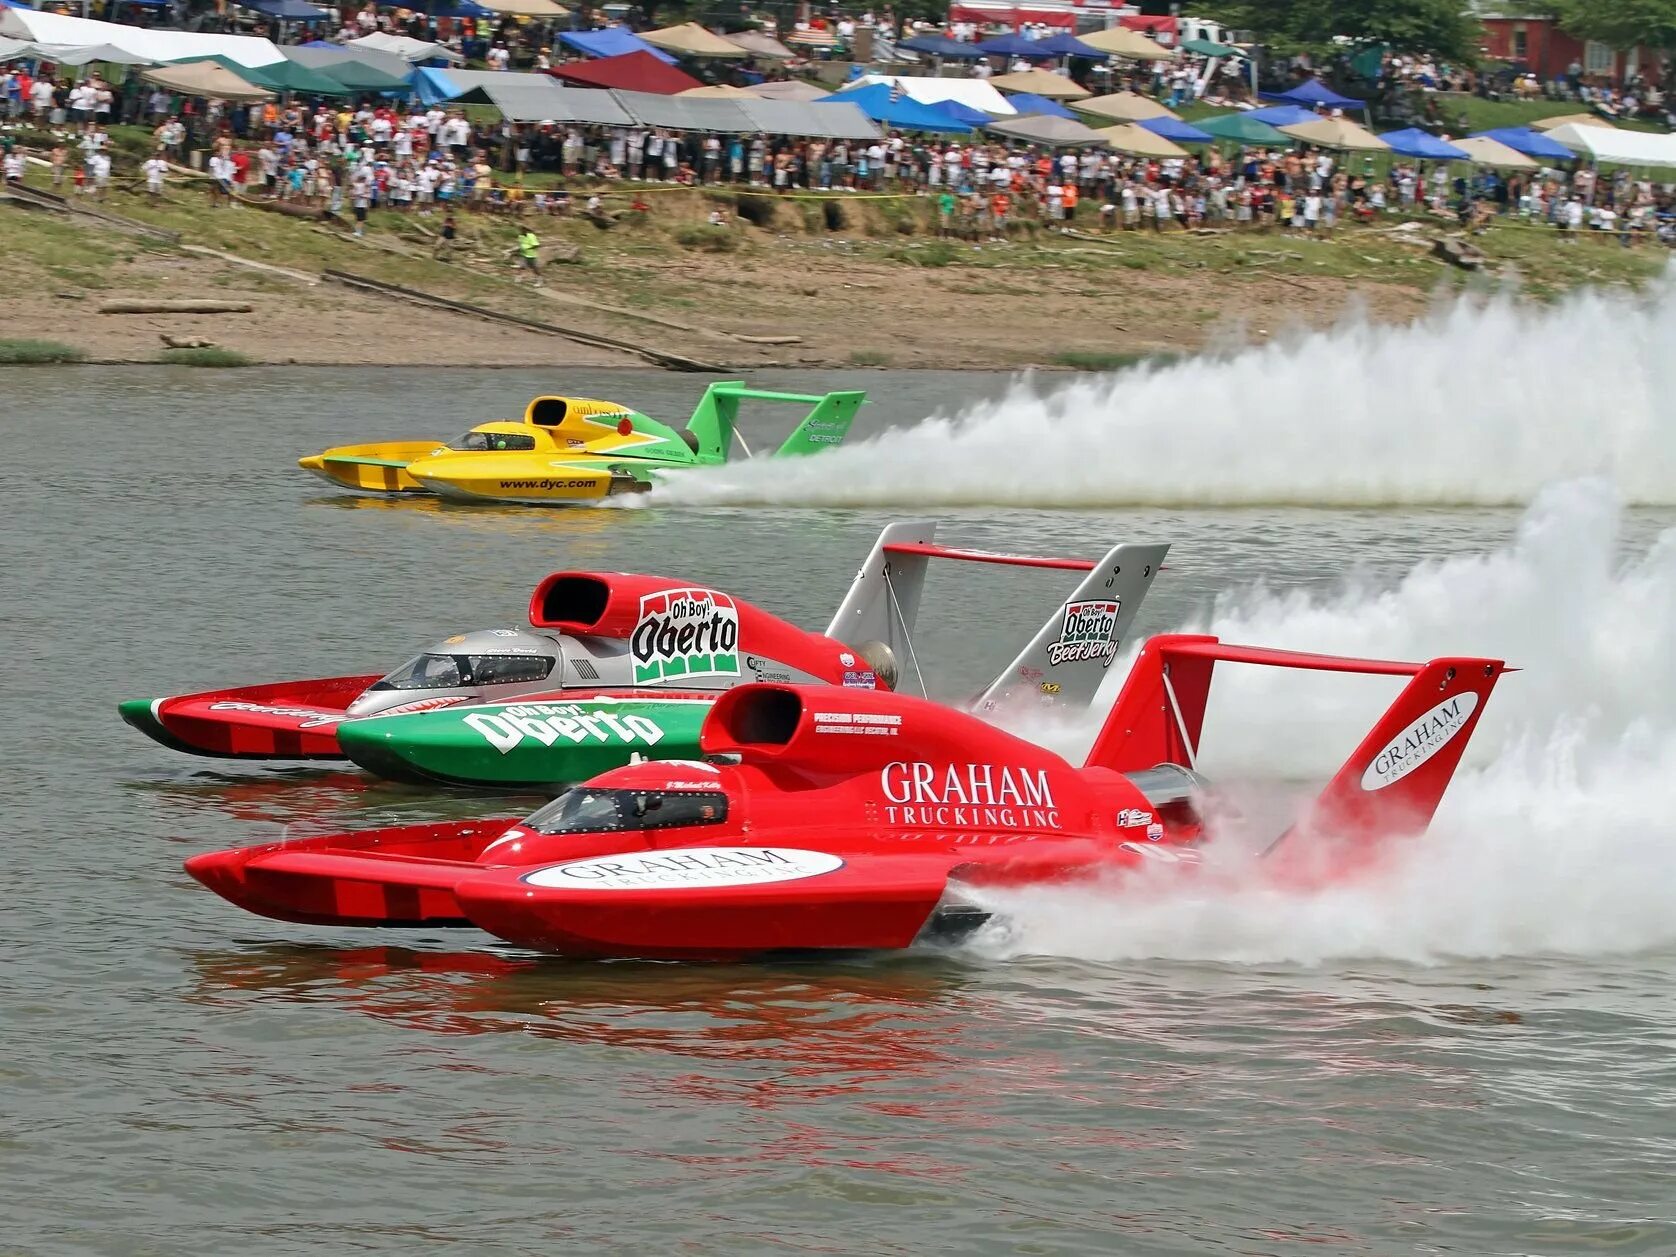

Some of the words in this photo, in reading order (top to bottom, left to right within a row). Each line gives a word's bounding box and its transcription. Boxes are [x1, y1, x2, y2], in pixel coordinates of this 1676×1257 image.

[499, 479, 597, 490] www.dyc.com
[672, 602, 687, 619] Oh
[688, 599, 711, 618] Boy!
[632, 611, 737, 663] Oberto
[1065, 612, 1113, 636] Oberto
[505, 704, 540, 717] Oh
[538, 704, 586, 716] Boy!
[814, 712, 852, 723] PRECISION
[853, 713, 902, 725] PERFORMANCE
[462, 710, 665, 755] Oberto
[1374, 698, 1461, 775] GRAHAM
[881, 761, 1056, 808] GRAHAM
[561, 849, 798, 881] GRAHAM
